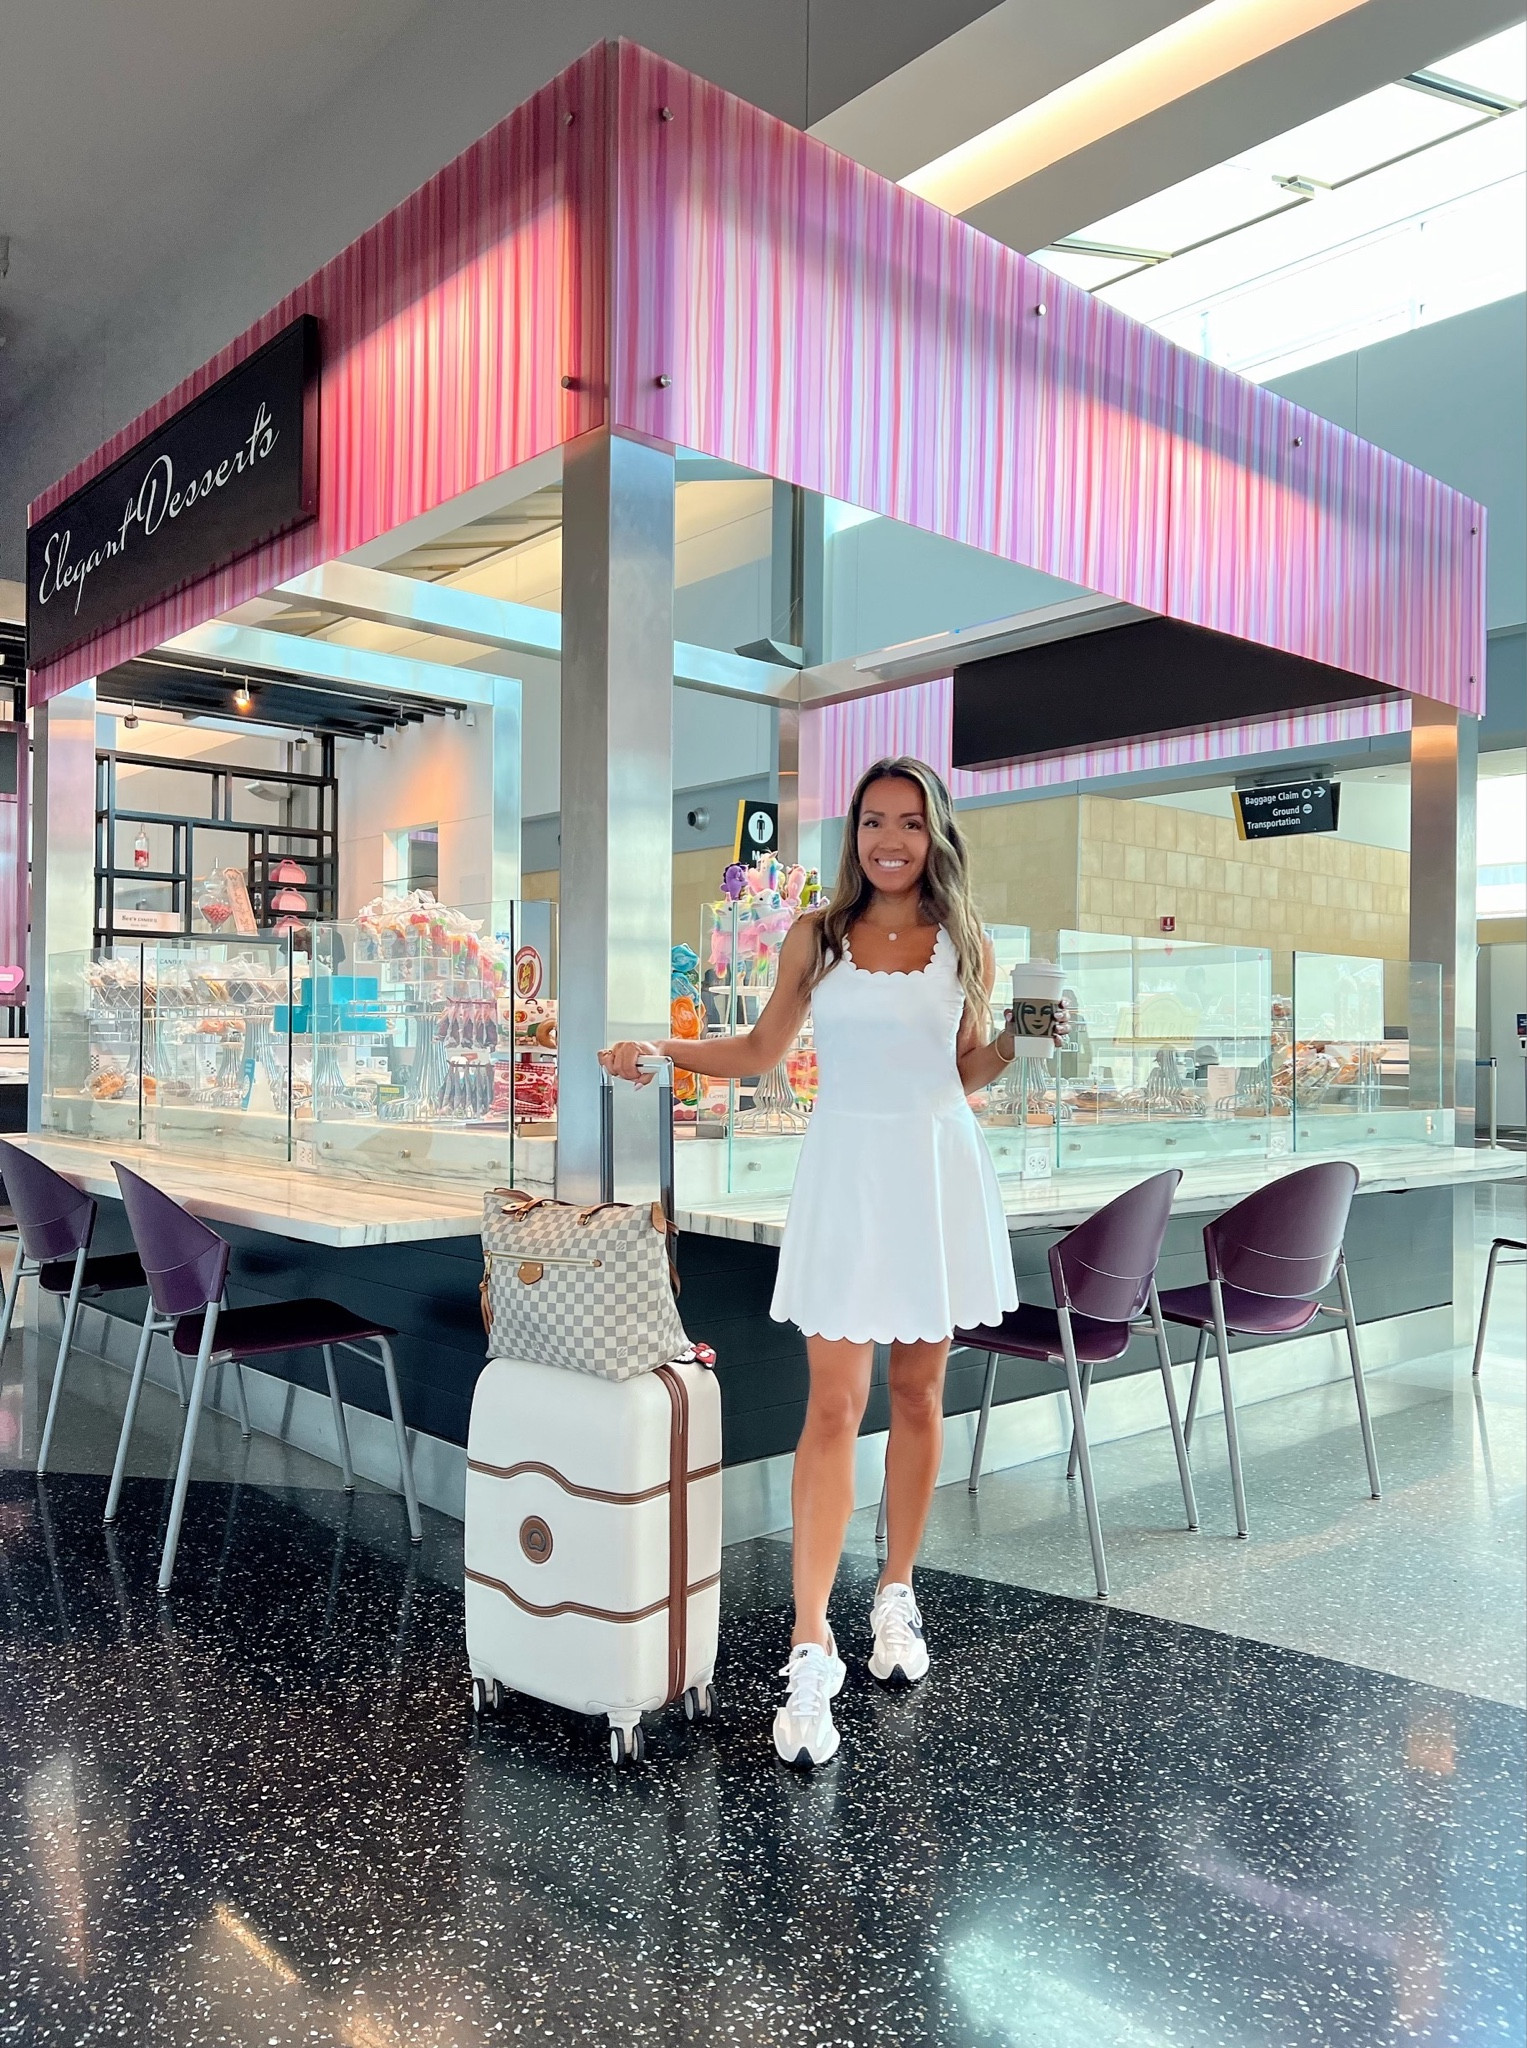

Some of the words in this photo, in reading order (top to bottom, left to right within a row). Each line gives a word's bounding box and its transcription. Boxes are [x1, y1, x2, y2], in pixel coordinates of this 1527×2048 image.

[38, 498, 137, 616] Elegant
[136, 401, 281, 536] Desserts
[1245, 794, 1277, 806] Baggage
[1277, 791, 1299, 801] Claim
[1272, 806, 1300, 817] Ground
[1247, 817, 1301, 830] Transportation
